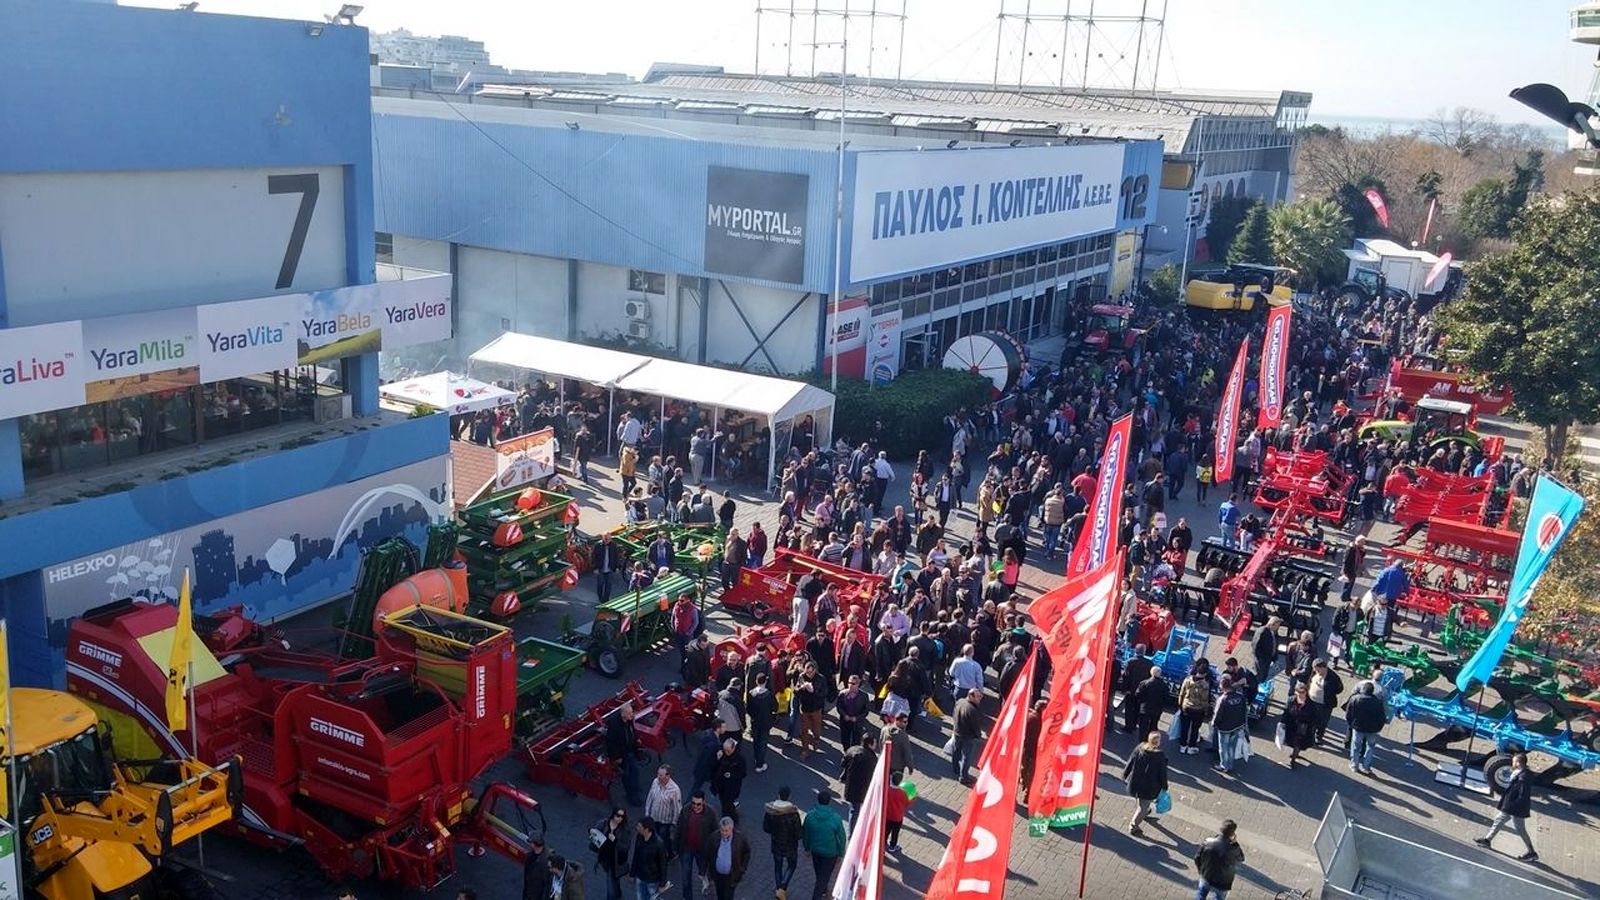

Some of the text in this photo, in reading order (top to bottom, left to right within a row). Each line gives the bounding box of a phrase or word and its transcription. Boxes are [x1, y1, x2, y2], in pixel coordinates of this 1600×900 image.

[872, 185, 965, 240] ΠΑΥΛΟΣ
[987, 174, 1083, 223] ΚΟΝΤΕΛΛΗΣ
[1121, 174, 1149, 220] 12
[268, 173, 320, 289] 7
[302, 312, 371, 338] YaraBela
[385, 302, 446, 324] YaraVera
[207, 326, 283, 353] YaraVita
[91, 340, 185, 371] YaraMila
[0, 357, 65, 385] aLiva
[49, 554, 116, 583] HELEXPO
[79, 642, 122, 667] GRIMME
[476, 666, 486, 718] GRIMME
[310, 718, 365, 747] GRIMME
[33, 825, 54, 844] JCB
